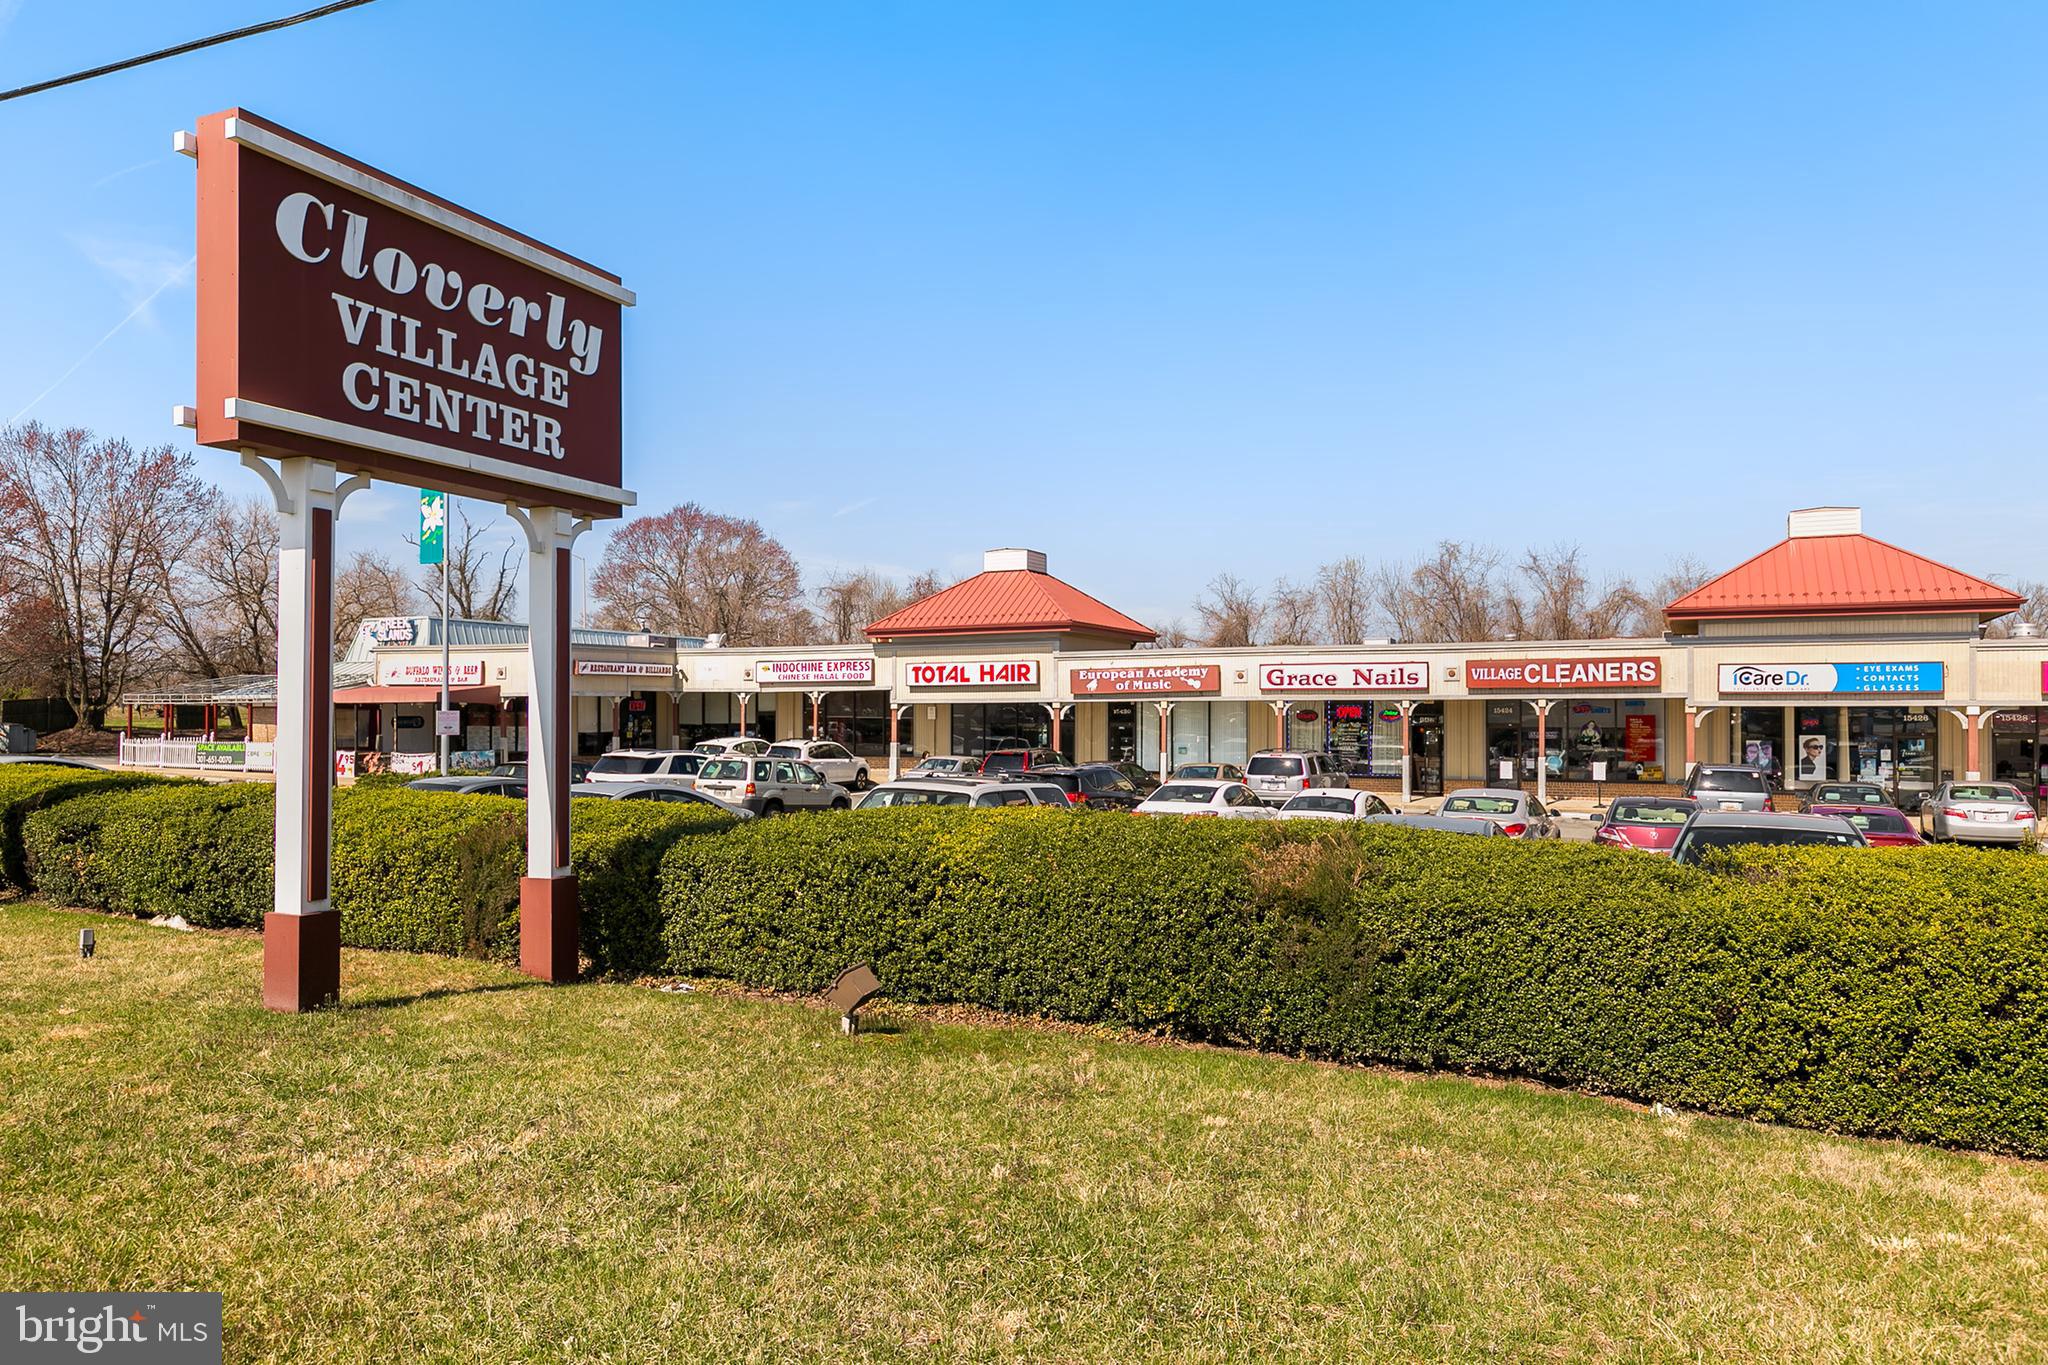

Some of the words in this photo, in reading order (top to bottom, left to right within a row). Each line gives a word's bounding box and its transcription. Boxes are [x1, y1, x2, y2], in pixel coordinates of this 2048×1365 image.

[276, 192, 603, 376] Cloverly
[332, 292, 570, 409] VILLAGE
[342, 362, 566, 461] CENTER
[379, 617, 411, 630] GREEK
[405, 665, 430, 675] BUFFALO
[463, 665, 478, 675] BEER
[590, 664, 625, 673] RESTAURANT
[626, 665, 636, 673] BAR
[645, 665, 672, 674] BILLIARDS
[772, 662, 823, 673] INDOCHINE
[827, 661, 870, 672] EXPRESS
[912, 665, 970, 683] TOTAL
[979, 663, 1030, 682] HAIR
[1471, 667, 1522, 680] VILLAGE
[1523, 661, 1656, 683] CLEANERS
[1885, 664, 1919, 672] EXAMS
[1079, 670, 1144, 681] European
[1147, 667, 1209, 678] Academy
[1266, 668, 1337, 686] Grace
[1352, 667, 1419, 686] Nails
[1862, 674, 1919, 682] CONTACTS
[1115, 680, 1127, 690] of
[1132, 679, 1172, 690] Music
[1336, 705, 1362, 719] OPEN
[197, 743, 215, 751] SPACE
[196, 755, 233, 764] 301-651-0070
